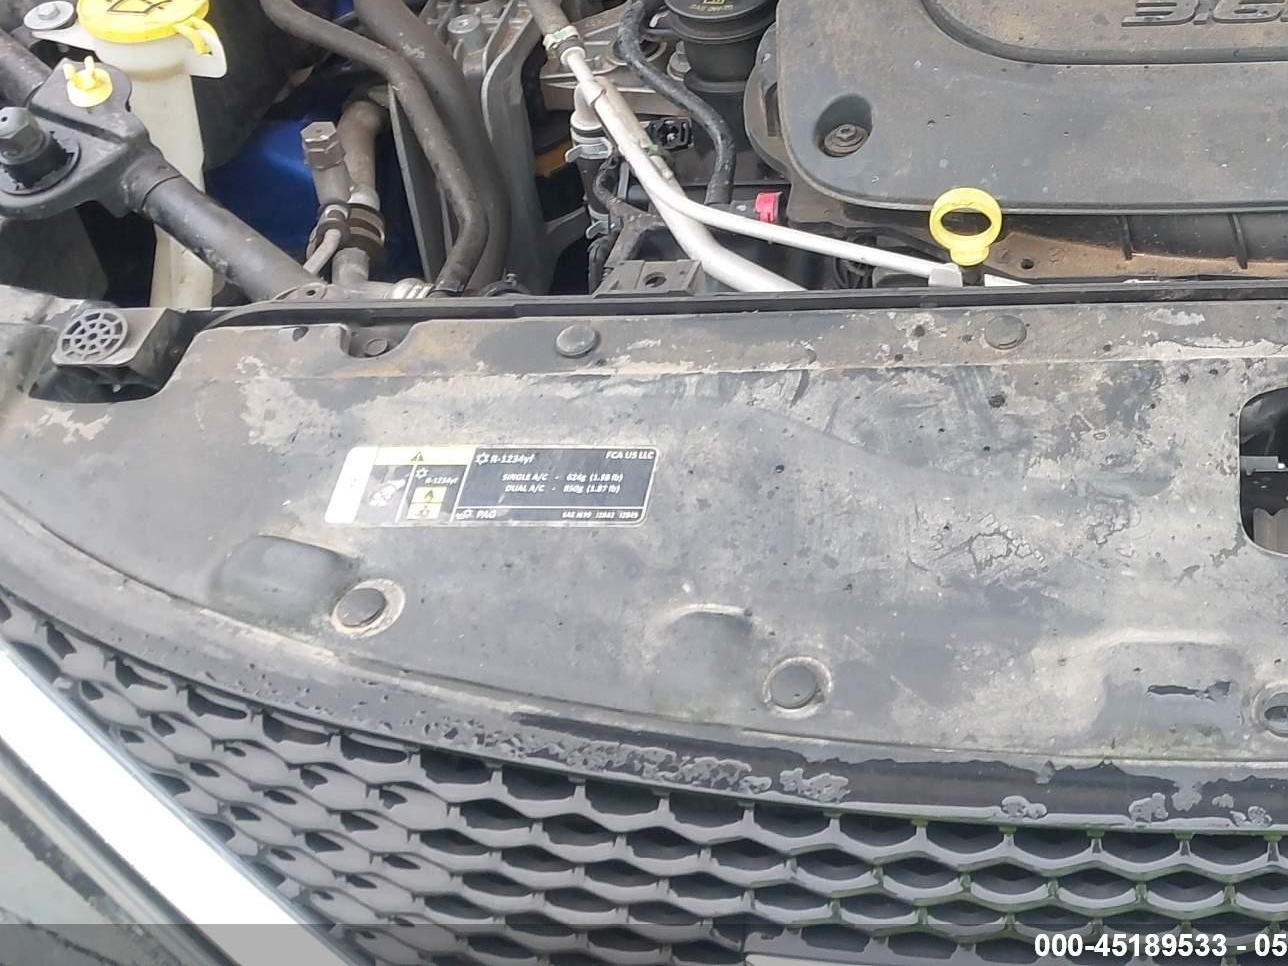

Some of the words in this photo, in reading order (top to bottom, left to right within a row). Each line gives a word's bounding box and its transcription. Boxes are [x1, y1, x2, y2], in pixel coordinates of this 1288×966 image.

[606, 450, 624, 459] FCA
[625, 450, 638, 459] US
[639, 450, 655, 459] LLC
[502, 473, 532, 481] SINGLE
[531, 473, 549, 482] A/C
[504, 484, 528, 492] DUAL
[527, 484, 545, 493] A/C
